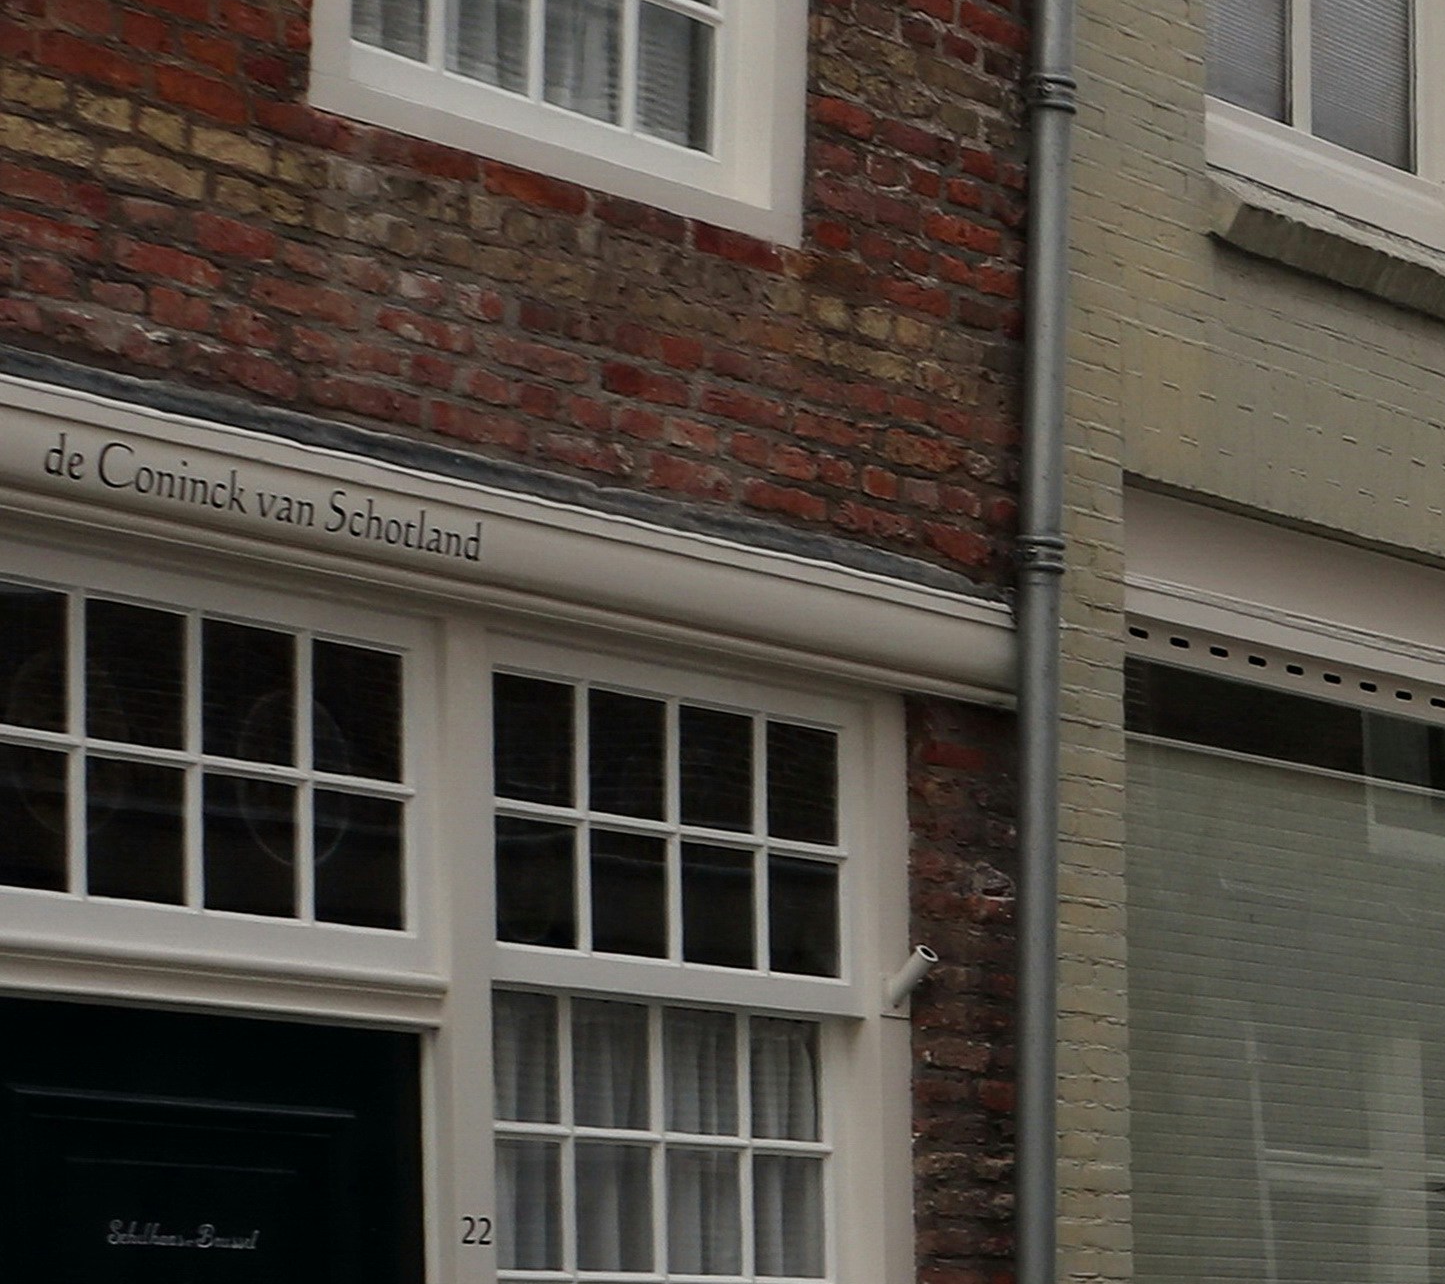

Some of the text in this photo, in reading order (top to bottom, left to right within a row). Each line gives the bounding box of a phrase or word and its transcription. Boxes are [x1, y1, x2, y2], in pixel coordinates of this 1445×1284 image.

[43, 432, 483, 562] de Coninck van Schotland
[461, 1216, 492, 1245] 22
